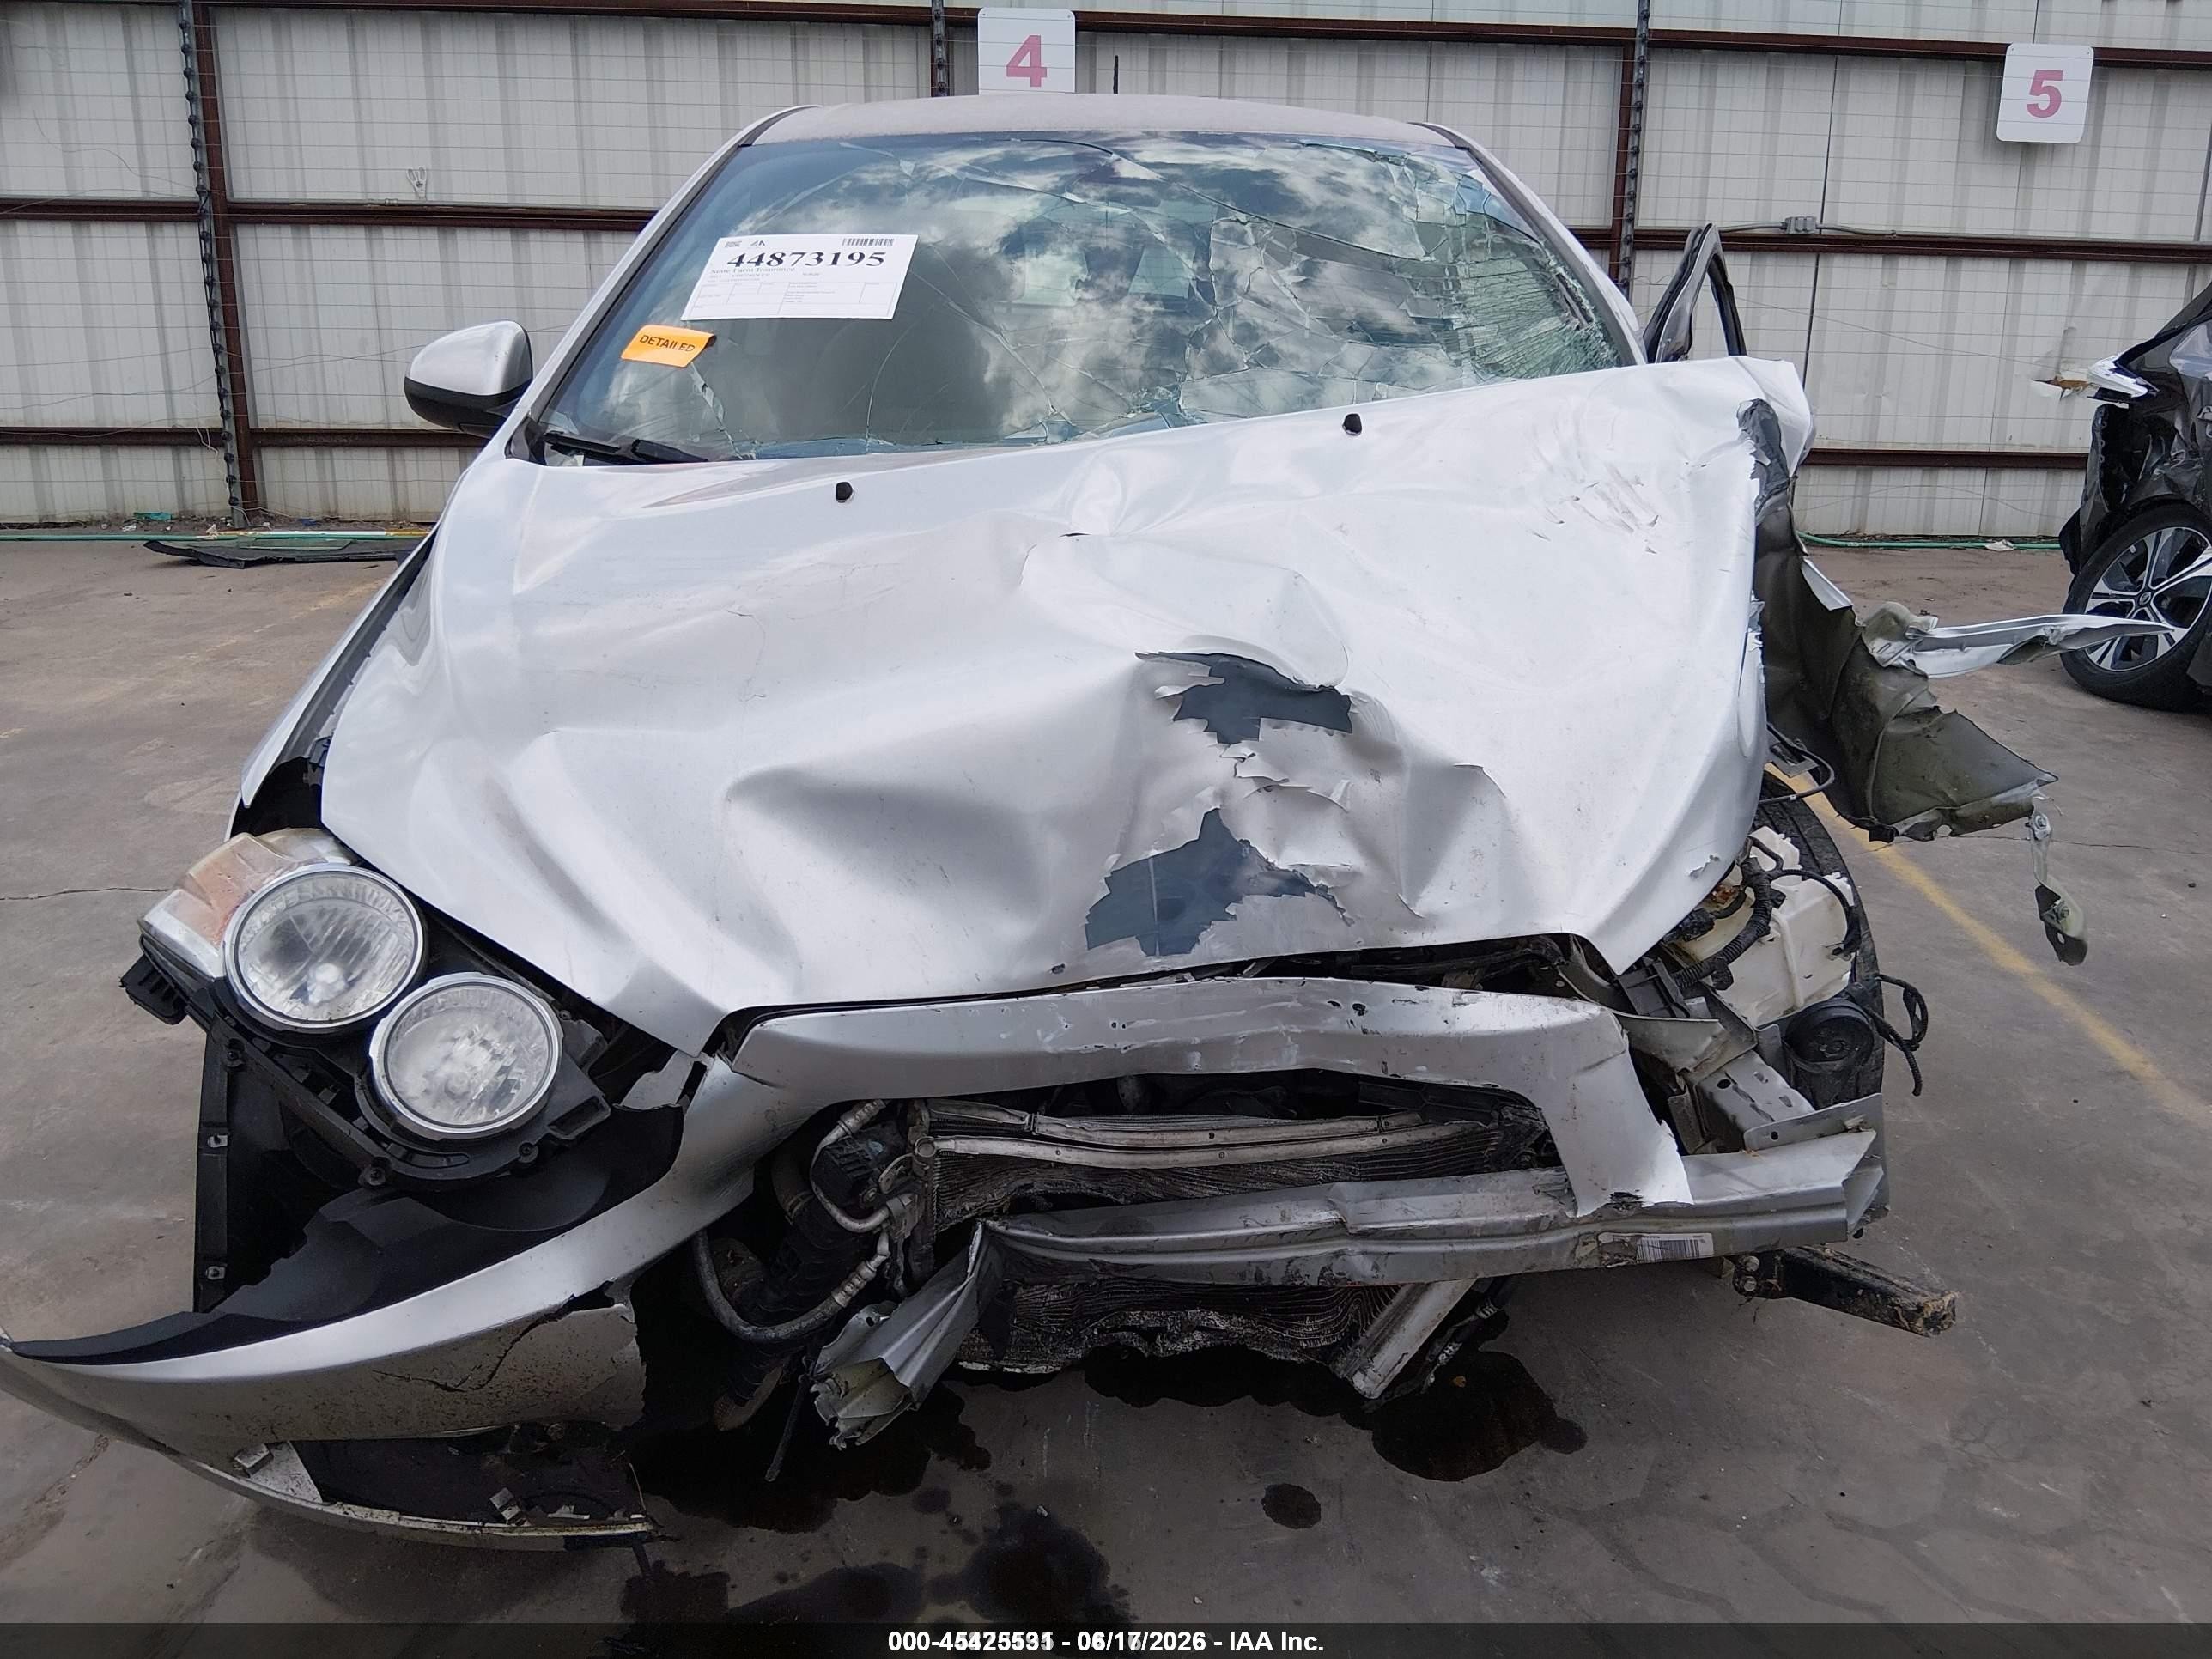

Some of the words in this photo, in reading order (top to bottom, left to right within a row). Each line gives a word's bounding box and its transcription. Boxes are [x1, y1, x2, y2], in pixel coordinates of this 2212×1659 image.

[1006, 35, 1047, 87] 4
[2027, 70, 2063, 118] 5
[727, 252, 886, 267] 44873195
[640, 334, 696, 352] DETAILED
